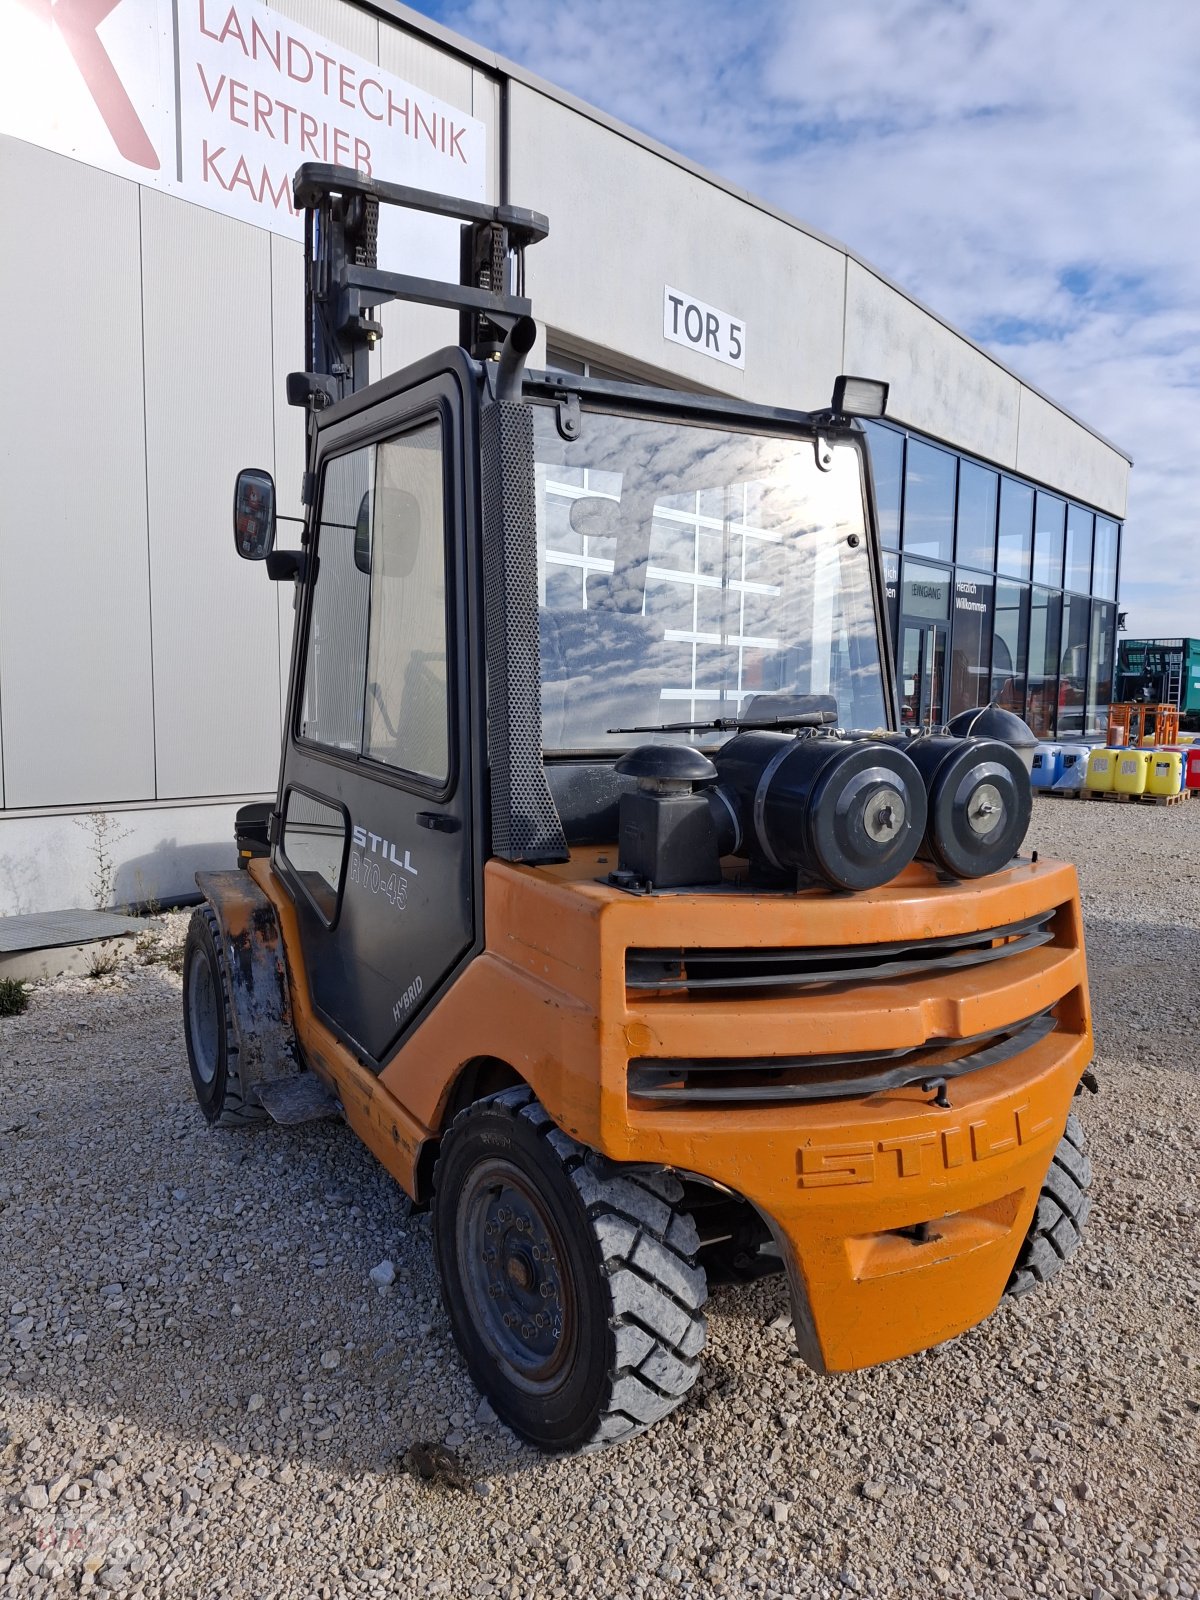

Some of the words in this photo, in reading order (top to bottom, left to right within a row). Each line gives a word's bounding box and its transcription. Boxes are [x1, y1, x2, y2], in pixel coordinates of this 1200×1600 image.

[198, 0, 467, 164] LANDTECHNIK
[196, 62, 373, 178] VERTRIEB
[202, 138, 300, 217] KAM
[668, 294, 720, 352] TOR
[728, 322, 742, 360] 5
[911, 583, 941, 600] EINGANG
[955, 597, 987, 613] Willkommen
[956, 581, 977, 595] Herzlich
[353, 825, 418, 875] STILL
[392, 975, 423, 1023] HYBRID
[795, 1105, 1053, 1189] STILL
